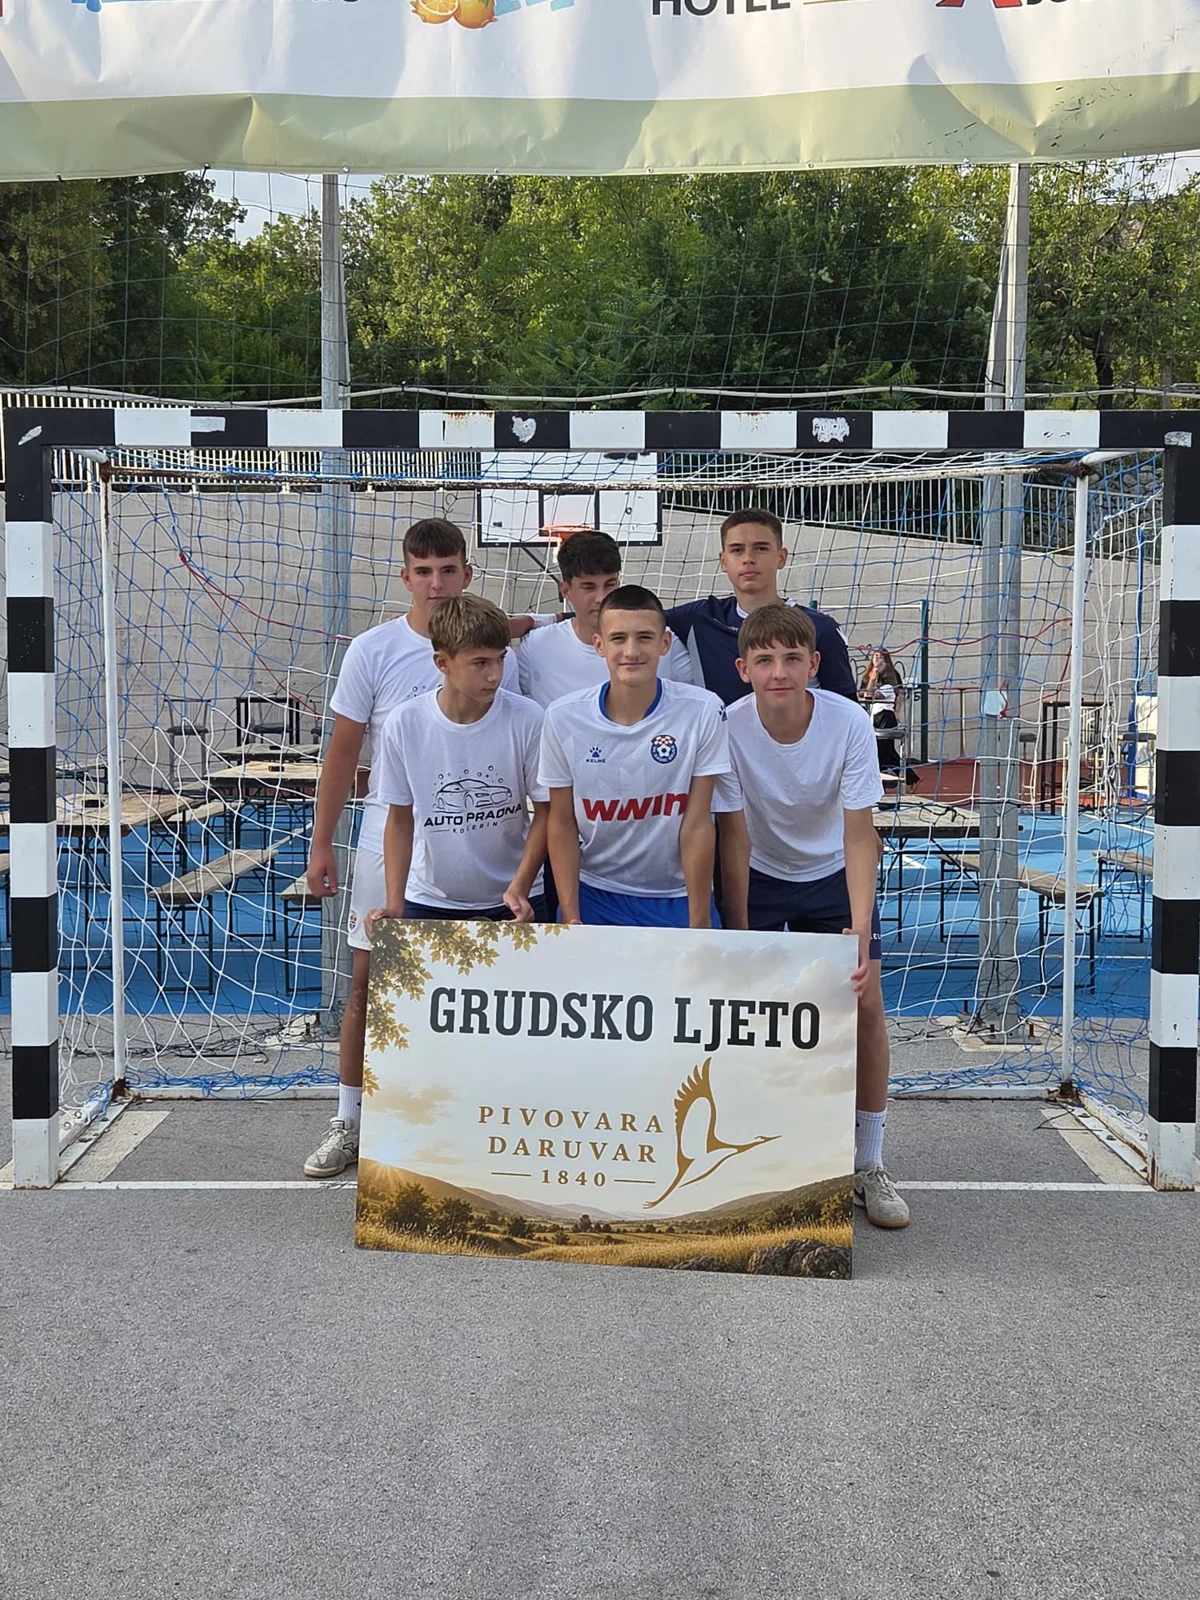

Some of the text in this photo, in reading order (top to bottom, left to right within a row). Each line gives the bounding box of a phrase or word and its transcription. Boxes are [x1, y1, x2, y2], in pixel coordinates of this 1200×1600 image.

[423, 815, 463, 827] AUTO
[429, 987, 820, 1052] GRUDSKO LJETO
[478, 1105, 664, 1134] PIVOVARA
[487, 1136, 657, 1164] DARUVAR
[541, 1169, 606, 1187] 1840
